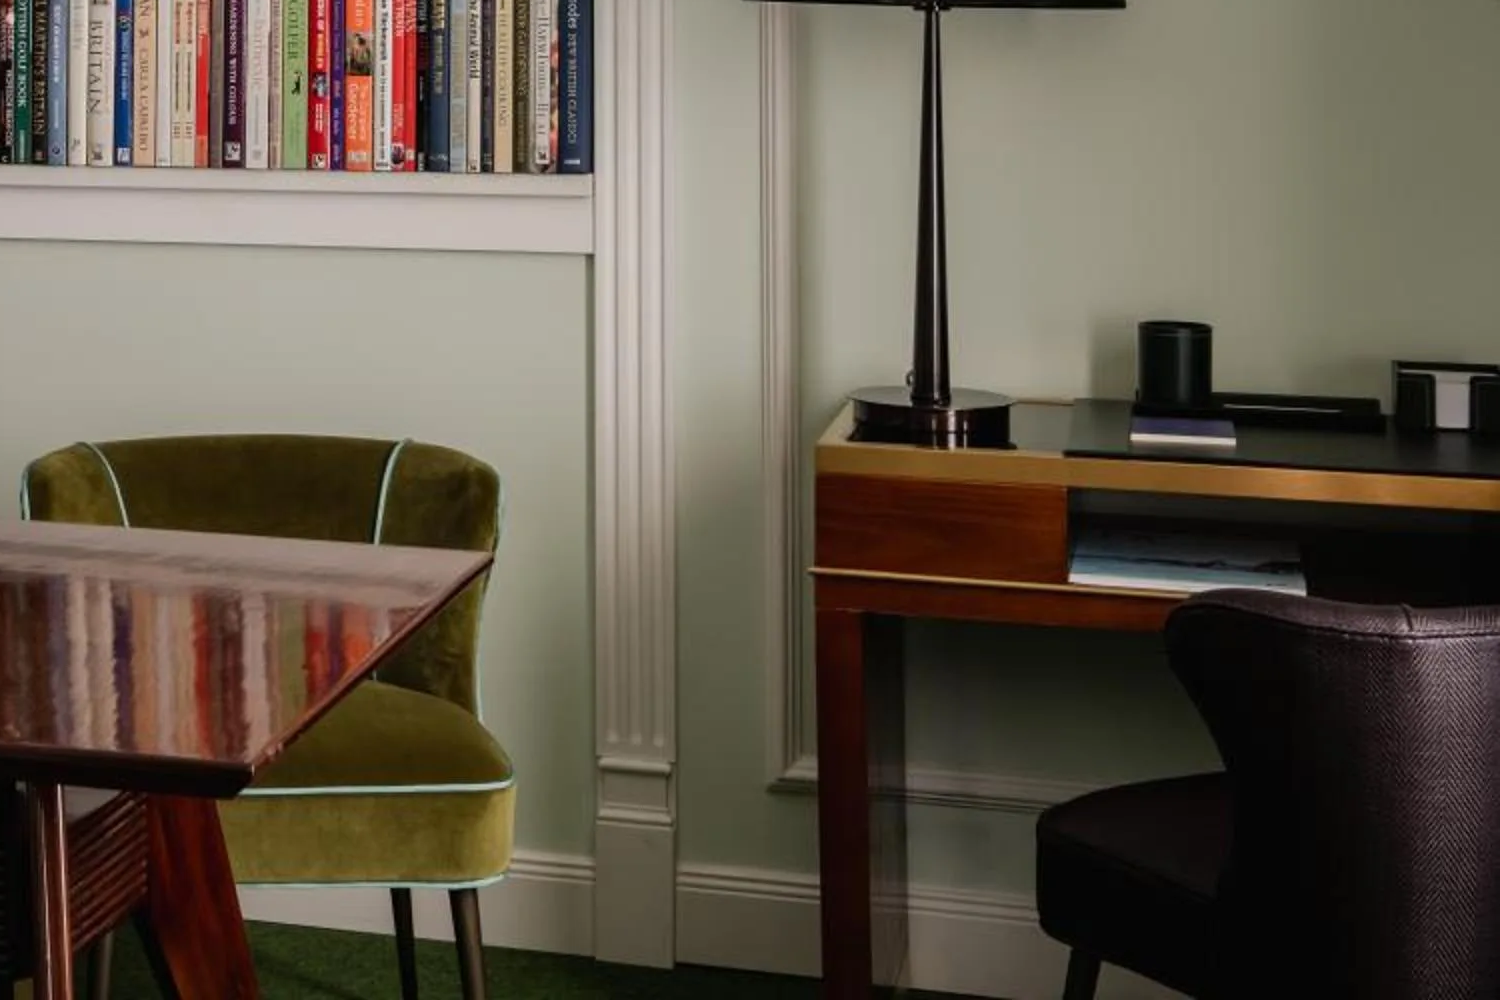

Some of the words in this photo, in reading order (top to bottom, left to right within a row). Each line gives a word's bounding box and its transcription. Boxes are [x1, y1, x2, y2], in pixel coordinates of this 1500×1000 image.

[17, 41, 27, 71] GOLF
[88, 20, 103, 114] BRITAIN
[17, 74, 27, 108] BOOK
